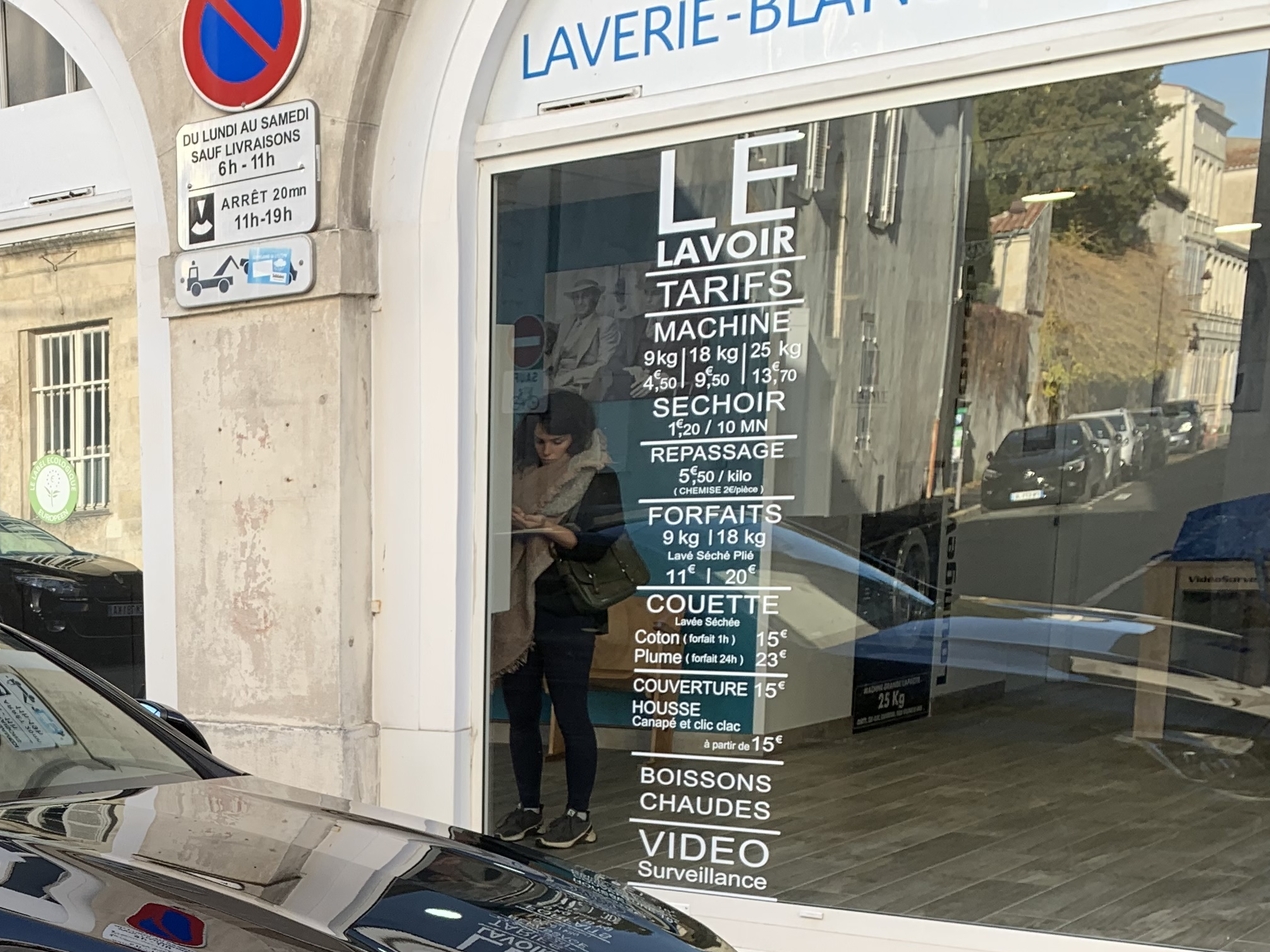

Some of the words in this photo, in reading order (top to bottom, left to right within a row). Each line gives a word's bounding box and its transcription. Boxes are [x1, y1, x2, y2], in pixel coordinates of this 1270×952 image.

[183, 131, 199, 147] DU
[203, 124, 237, 142] LUNDI
[241, 119, 257, 135] AU
[261, 107, 309, 129] SAMEDI
[191, 145, 221, 163] SAUF
[225, 128, 300, 157] LIVRAISONS
[251, 152, 275, 171] 11h
[658, 129, 799, 235] LE
[221, 189, 268, 210] ARRÊT
[273, 185, 307, 202] 20mn
[234, 206, 292, 231] 11h-19h
[657, 226, 795, 268] LAVOIR
[656, 269, 792, 308] TARIFS
[654, 310, 790, 343] MACHINE
[690, 346, 711, 363] 18
[717, 345, 738, 364] kg
[751, 342, 771, 359] 25
[779, 340, 802, 359] kg
[653, 391, 786, 418] SECHOIR
[717, 421, 735, 434] 10
[741, 419, 768, 433] MN
[651, 442, 784, 463] REPASSAGE
[32, 461, 46, 480] LABEL
[727, 470, 752, 482] kilo
[30, 482, 35, 491] LE
[679, 486, 721, 495] CHEMISE
[648, 504, 782, 526] FORFAITS
[663, 530, 674, 545] 9
[678, 530, 699, 548] kg
[717, 529, 738, 545] 18
[744, 529, 766, 548] kg
[668, 550, 693, 561] Lavé
[696, 550, 730, 561] Séché
[733, 550, 754, 561] Plié
[647, 594, 779, 615] COUETTE
[675, 617, 703, 627] Lavée
[705, 617, 740, 628] Séchée
[635, 629, 680, 645] Coton
[689, 634, 715, 644] forfait
[718, 635, 729, 644] 1h
[757, 629, 787, 647] 15€
[634, 648, 682, 664] Plume
[691, 654, 717, 664] forfait
[719, 655, 737, 664] 24h
[755, 650, 787, 668] 23€
[633, 678, 748, 697] COUVERTURE
[754, 680, 786, 699] 15€
[632, 700, 701, 717] HOUSSE
[878, 692, 890, 710] 25
[892, 690, 905, 709] Kg
[632, 715, 676, 730] Canapé
[680, 718, 691, 730] et
[695, 719, 714, 731] clic
[716, 720, 741, 732] clac
[704, 740, 710, 749] à
[712, 740, 736, 751] partir
[738, 740, 750, 750] de
[752, 735, 783, 752] 15€
[640, 766, 772, 793] BOISSONS
[640, 792, 771, 821] CHAUDES
[639, 829, 769, 868] VIDEO
[638, 860, 767, 890] Surveillance
